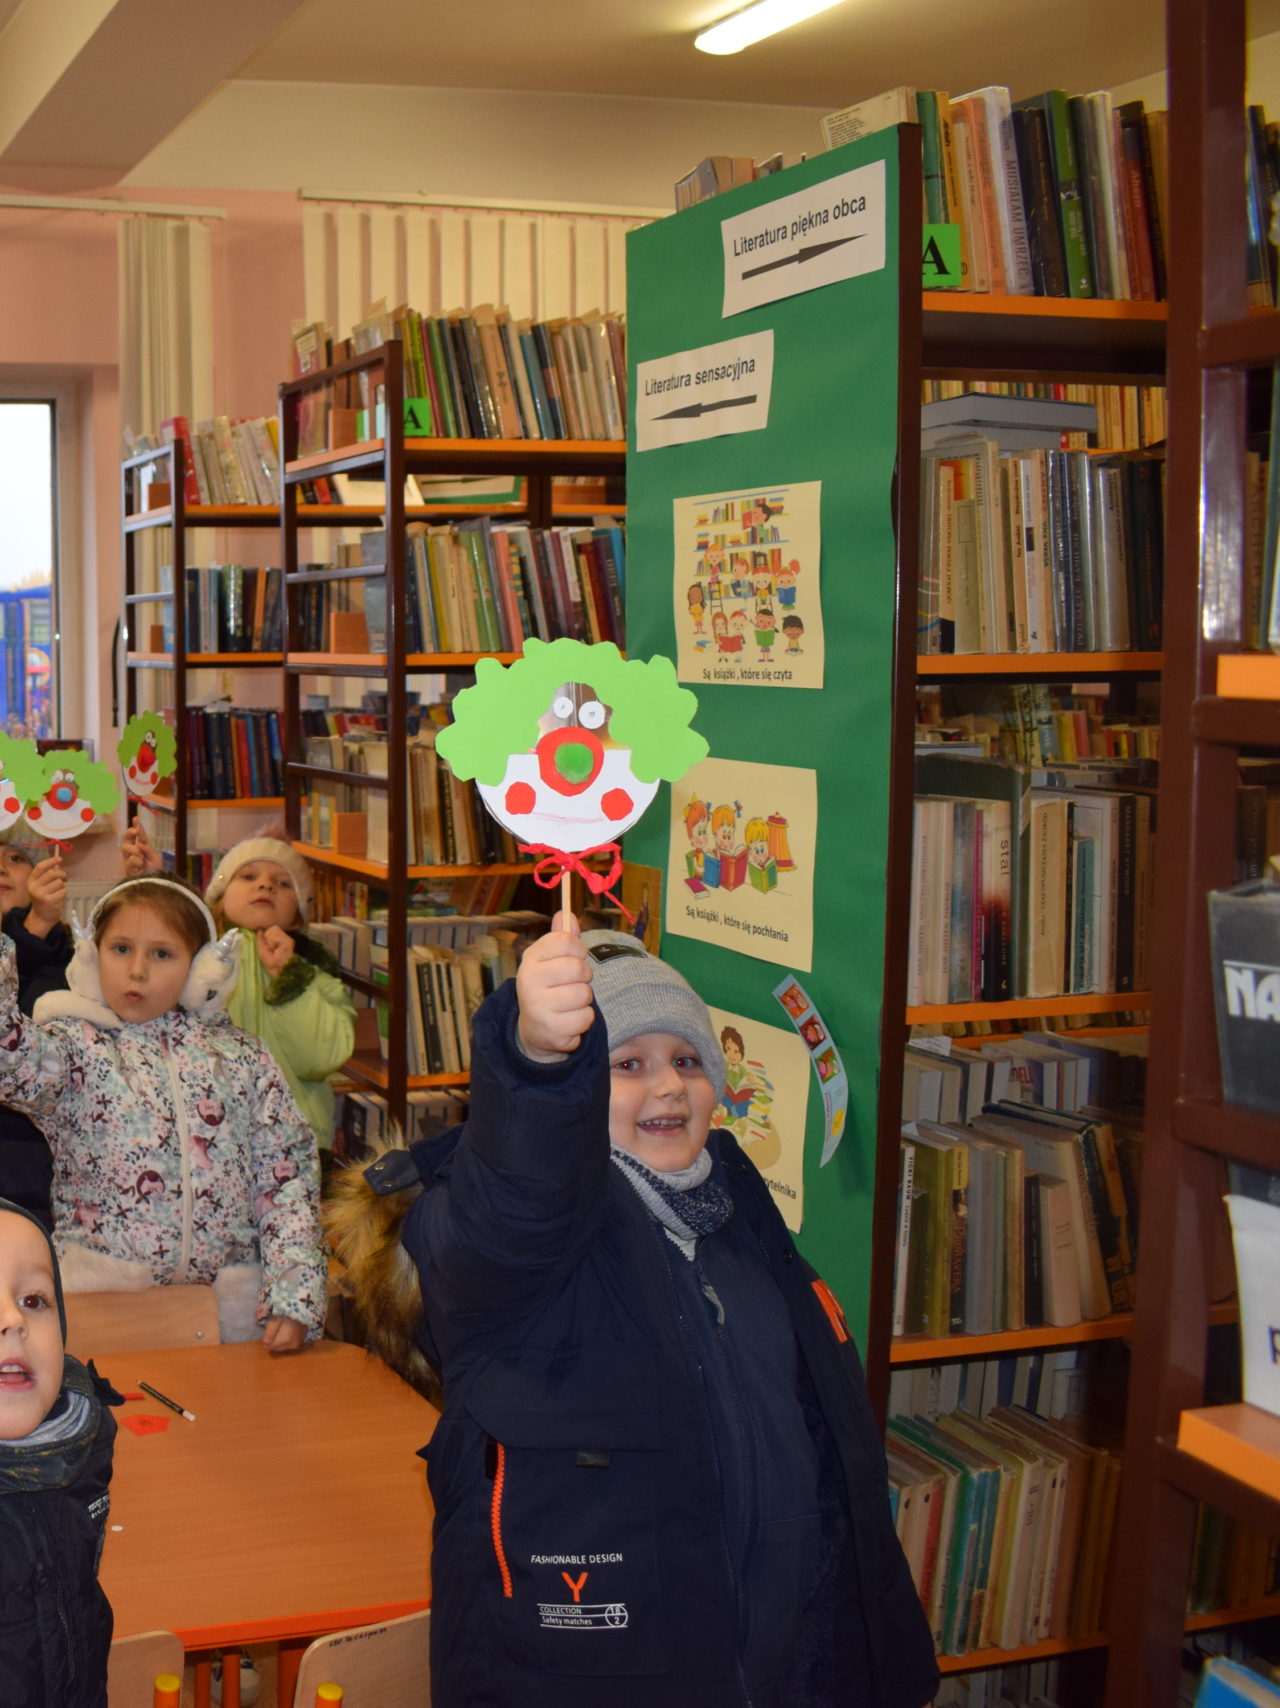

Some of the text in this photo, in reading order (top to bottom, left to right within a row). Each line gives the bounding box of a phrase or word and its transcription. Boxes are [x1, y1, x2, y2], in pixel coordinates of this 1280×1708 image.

[733, 195, 867, 257] Literatura piękna obca
[921, 235, 951, 275] A
[645, 356, 756, 396] Literatura sensacyjna
[403, 405, 424, 430] A
[703, 667, 793, 681] Są książki które się czyta
[1000, 839, 1010, 876] stal
[686, 905, 789, 942] Są książki które się pochłania
[530, 1553, 623, 1564] FASHIONABLE DESIGN
[561, 1571, 589, 1603] Y
[540, 1606, 582, 1615] COLLECTION
[542, 1615, 620, 1626] Safety matches 2
